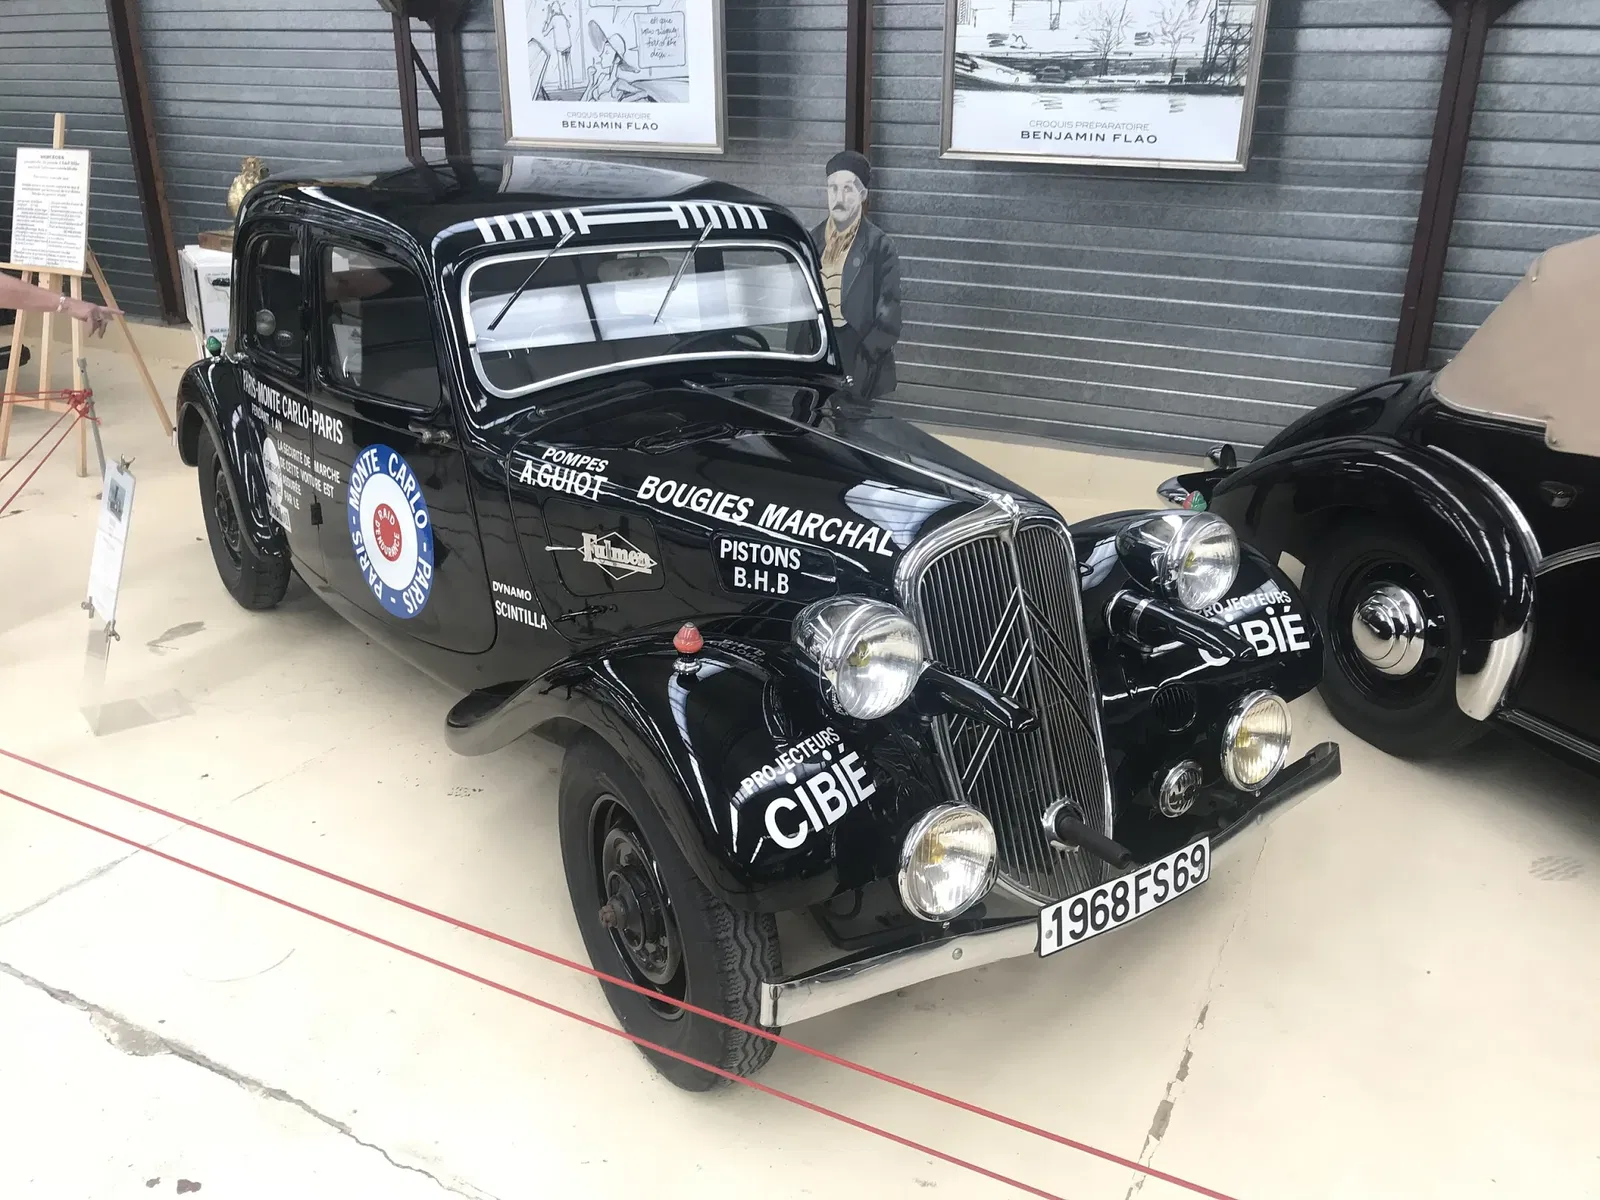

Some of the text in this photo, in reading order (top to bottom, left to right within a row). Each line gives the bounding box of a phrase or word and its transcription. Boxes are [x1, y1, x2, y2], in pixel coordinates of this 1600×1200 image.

[562, 120, 659, 131] BENJAMIN FLAO
[566, 111, 598, 119] CROQUIS
[1029, 119, 1073, 129] CROQUIS
[1021, 130, 1158, 144] BENJAMIN FLAO
[303, 454, 311, 468] DE
[314, 460, 341, 484] MARCHE
[541, 447, 609, 473] POMPES
[300, 469, 322, 492] VOITURE
[323, 482, 334, 498] EST
[293, 497, 300, 510] LE
[377, 507, 396, 525] RAID
[637, 475, 894, 557] BOUGIES MARCHAL
[349, 448, 432, 614] MONTE CARLO PARIS PARIS
[581, 532, 650, 569] Fulmen
[720, 539, 801, 570] PISTONS
[492, 580, 532, 601] DYNAMO
[1196, 590, 1292, 618] ROJECTEURS
[495, 600, 548, 630] SCINTILLA
[740, 726, 840, 796] PROJECTEURS
